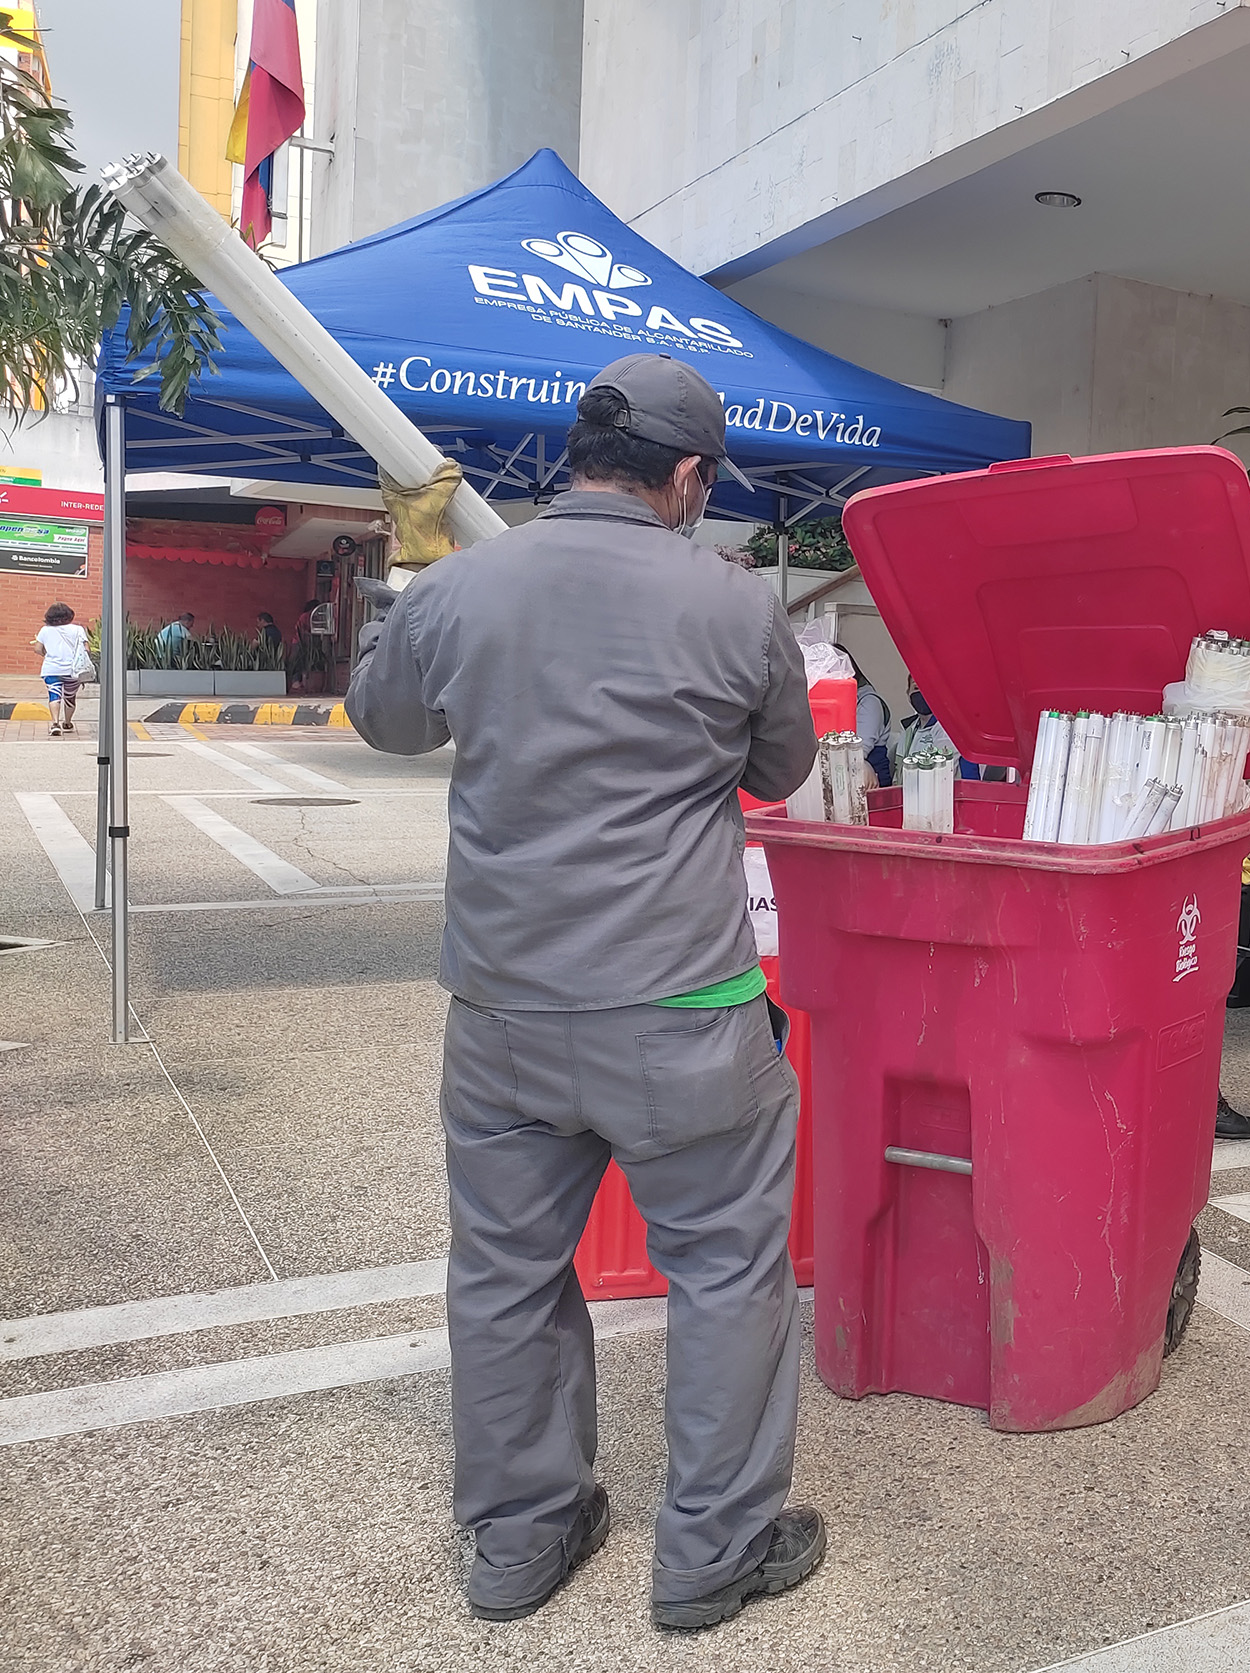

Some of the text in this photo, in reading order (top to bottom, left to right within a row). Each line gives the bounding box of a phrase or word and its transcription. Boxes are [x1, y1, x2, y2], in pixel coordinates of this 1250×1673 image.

[467, 264, 744, 349] EMPAS
[474, 296, 754, 359] EMPRESA PÚBLICA DE ALCANTARILLADO
[531, 313, 553, 324] DE
[555, 318, 642, 341] SANTANDER
[716, 391, 882, 448] adDeVida
[18, 554, 61, 565] Bancolombia
